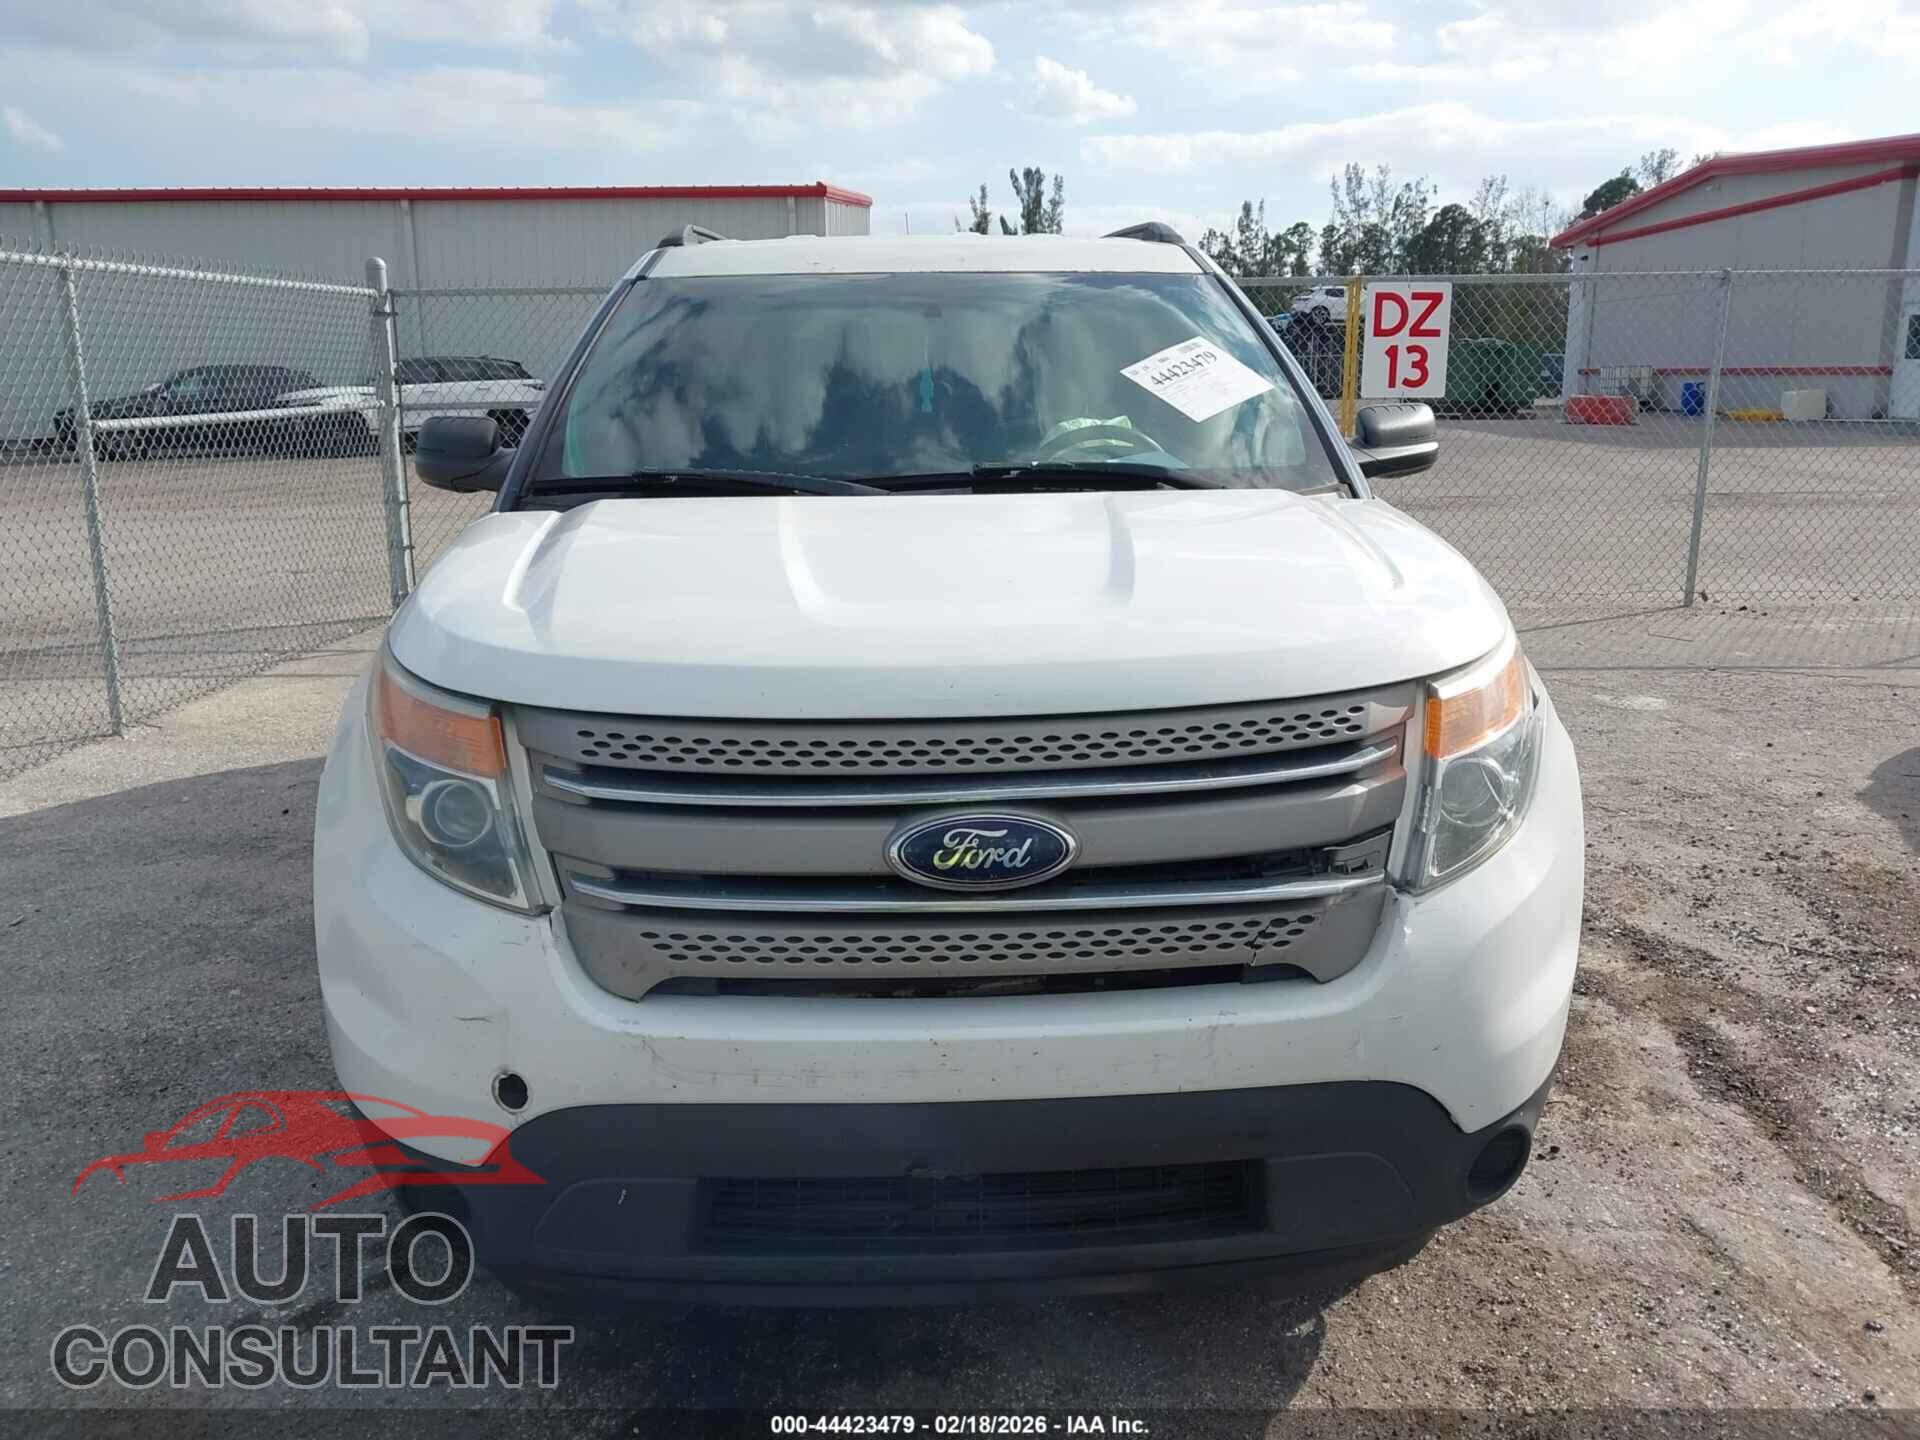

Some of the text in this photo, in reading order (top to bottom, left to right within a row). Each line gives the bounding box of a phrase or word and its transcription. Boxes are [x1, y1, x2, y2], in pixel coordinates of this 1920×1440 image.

[1373, 292, 1444, 337] DZ
[1150, 350, 1218, 386] 44423479
[1385, 345, 1429, 389] 13
[933, 828, 1033, 870] Ford
